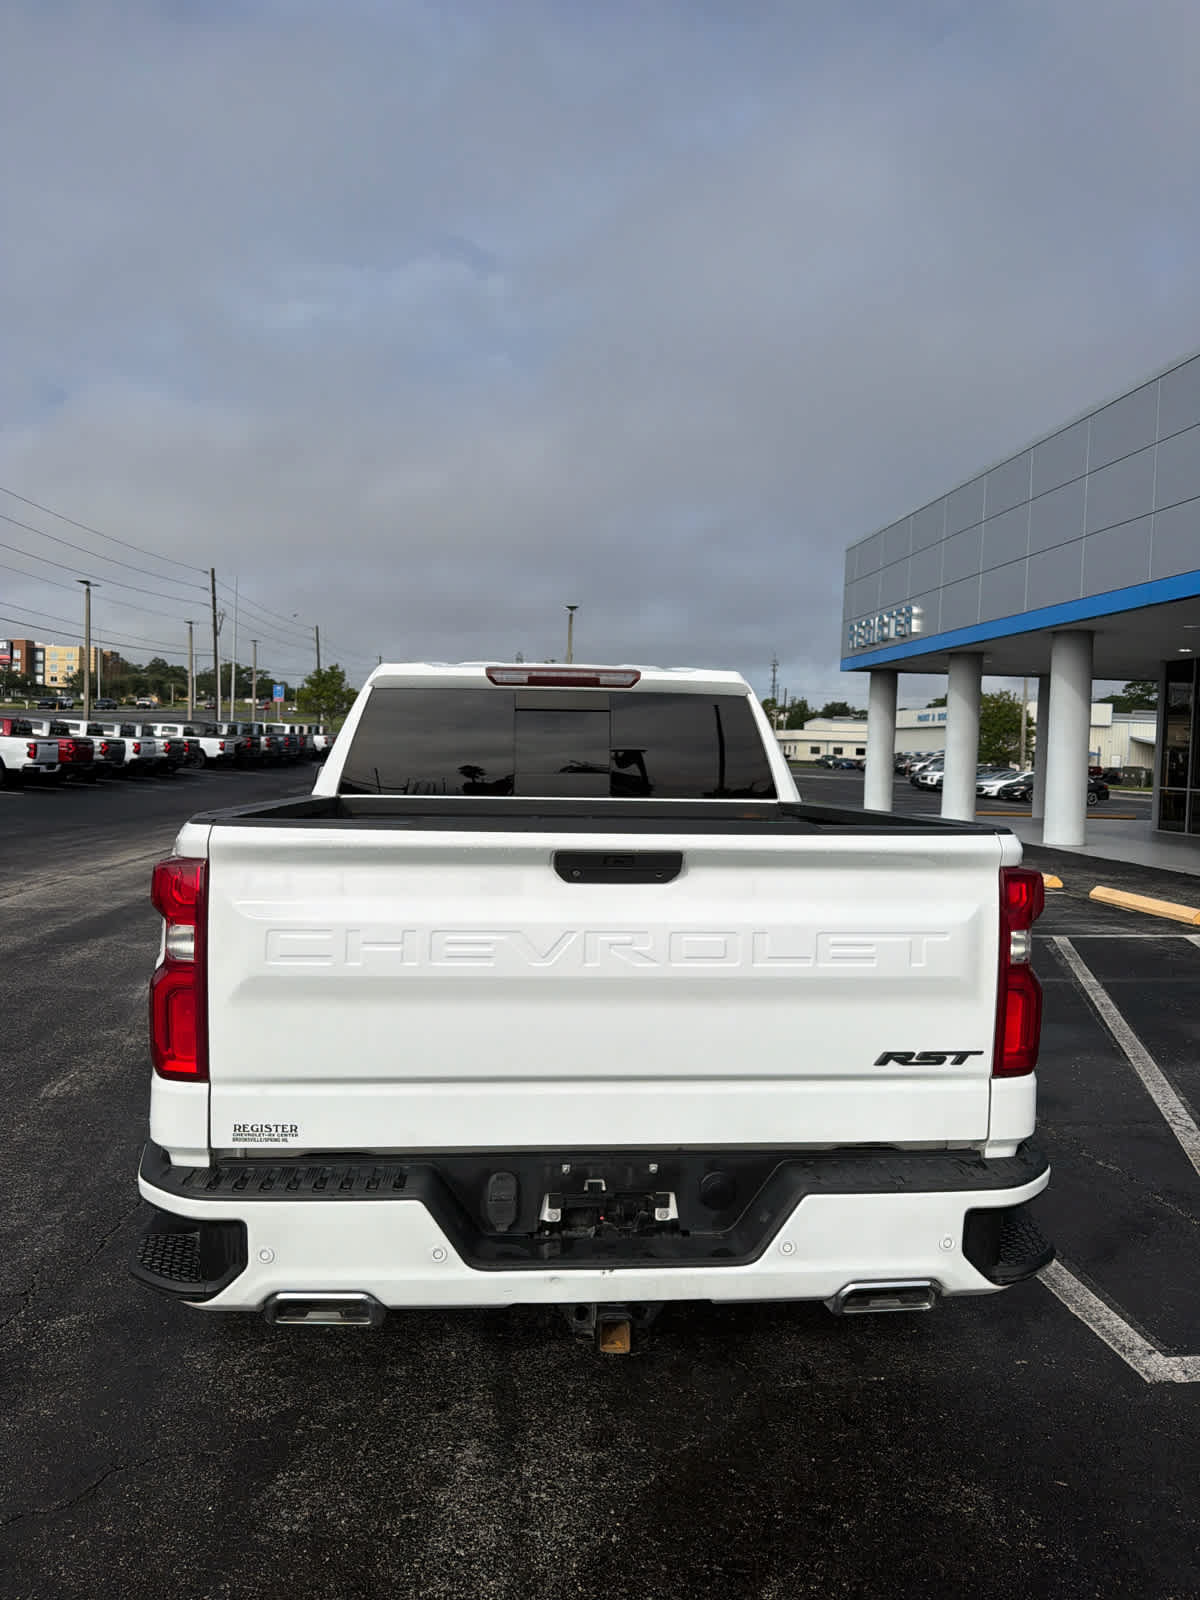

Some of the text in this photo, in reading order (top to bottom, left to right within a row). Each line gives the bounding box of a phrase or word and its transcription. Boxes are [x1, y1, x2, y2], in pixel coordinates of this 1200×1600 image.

[848, 606, 917, 649] REGISTER
[265, 928, 950, 967] CHEVROLET
[873, 1050, 984, 1066] RST
[233, 1124, 298, 1133] REGISTER
